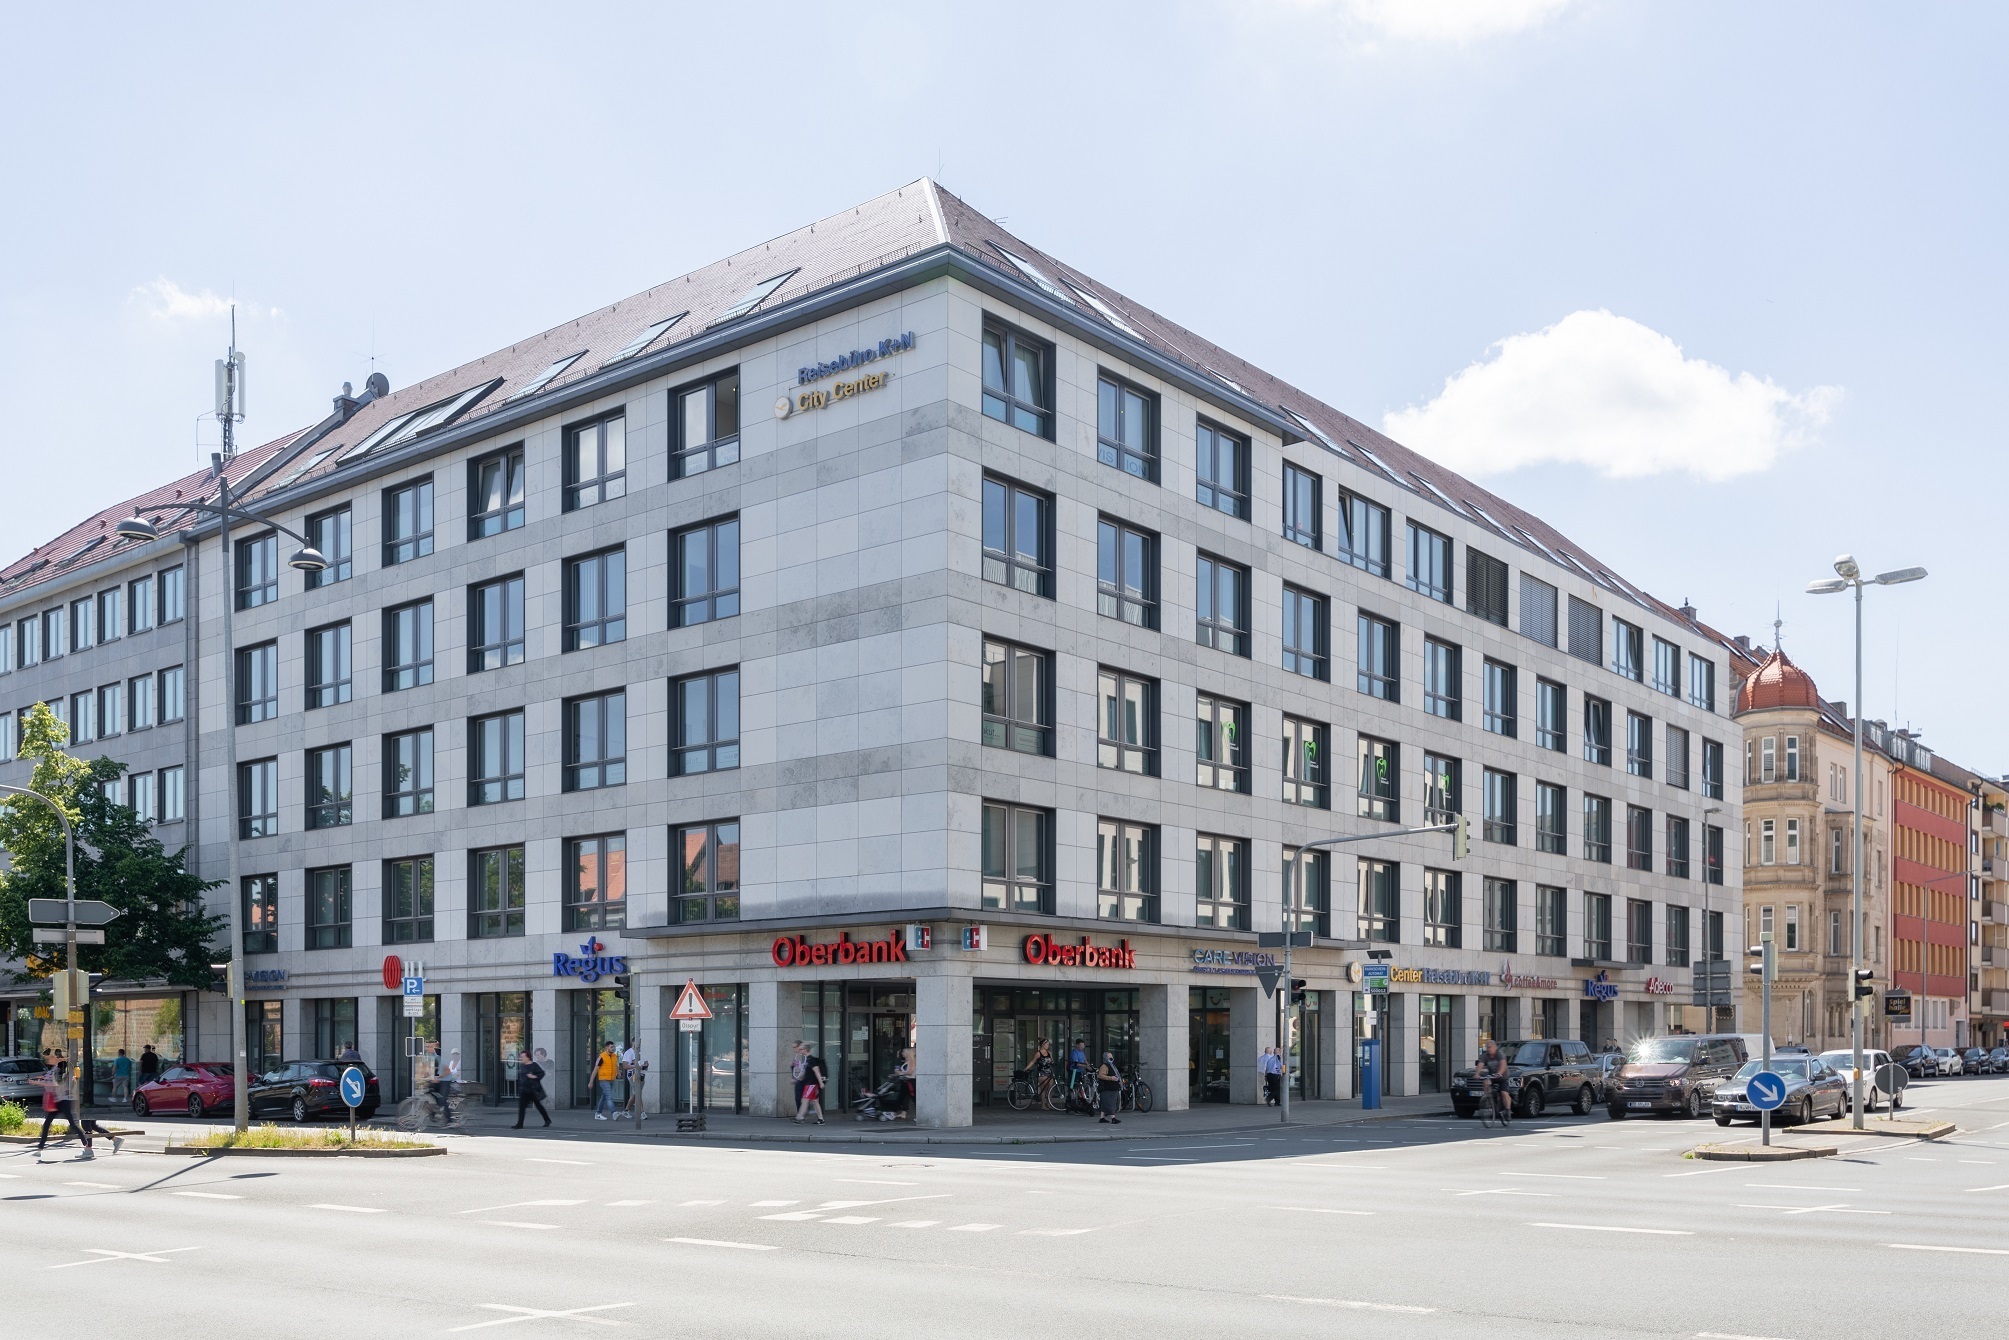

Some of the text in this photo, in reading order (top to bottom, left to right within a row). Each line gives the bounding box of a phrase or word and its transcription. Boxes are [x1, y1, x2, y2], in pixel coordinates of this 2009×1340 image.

[798, 331, 916, 385] Reisebüro K+N
[797, 371, 888, 411] City Center
[772, 929, 909, 967] Oberbank
[1023, 933, 1137, 969] Oberbank
[1193, 948, 1276, 967] CARE VISION
[553, 953, 628, 983] Regus
[1390, 966, 1423, 983] Center
[406, 979, 418, 994] P
[1513, 976, 1558, 990] coffee&more
[1585, 979, 1619, 1003] Regus
[1647, 977, 1674, 994] Adecco
[1889, 998, 1906, 1006] Spiel
